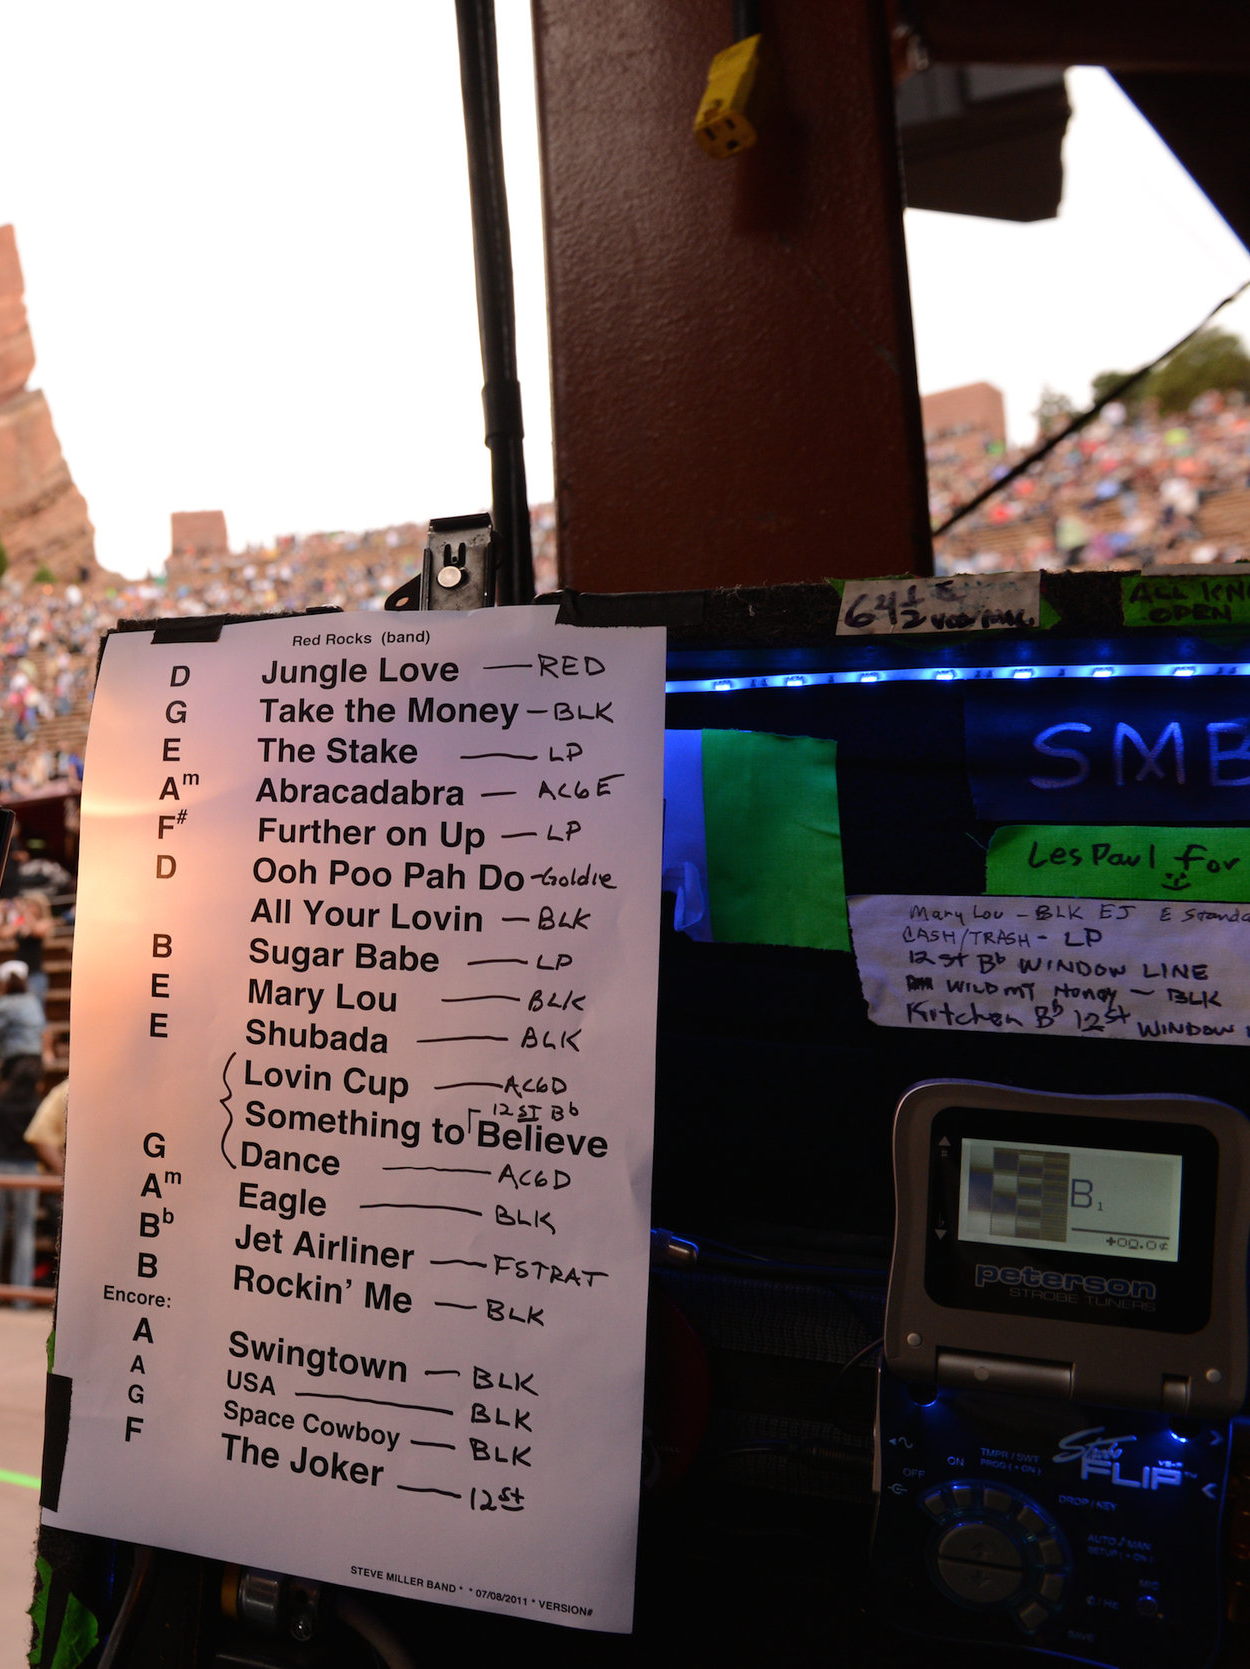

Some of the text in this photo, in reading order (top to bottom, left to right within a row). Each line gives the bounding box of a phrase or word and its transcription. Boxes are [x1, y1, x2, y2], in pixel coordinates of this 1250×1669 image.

[1202, 581, 1250, 602] KN
[1150, 604, 1231, 622] OPEN
[293, 631, 430, 646] Red Rocks (band)
[170, 666, 190, 687] D
[262, 658, 459, 689] Jungle Love
[538, 654, 605, 678] RED
[166, 700, 186, 723] G
[260, 697, 519, 730] Take the Money
[554, 702, 613, 723] BLK
[163, 738, 180, 761] E
[258, 738, 417, 764] The Stake
[550, 742, 583, 761] LP
[256, 778, 464, 806] Abracadabra
[259, 818, 485, 854] Further on Up
[547, 821, 581, 841] LP
[157, 855, 176, 878] D
[1028, 841, 1082, 868] Les
[1091, 844, 1156, 868] Paul
[253, 857, 524, 891] Ooh Poo Pah Do
[251, 898, 482, 932] All Your Lovin
[538, 906, 590, 930] BLK
[909, 905, 965, 925] Mary
[973, 905, 1004, 920] Lou
[1036, 904, 1084, 921] BLK
[153, 934, 172, 958] B
[1064, 928, 1102, 948] LP
[250, 938, 439, 972] Sugar Babe
[537, 954, 572, 970] LP
[1019, 957, 1126, 978] WINDOW
[1142, 963, 1208, 980] LINE
[152, 973, 169, 998] E
[249, 979, 396, 1014] Mary Lou
[1167, 987, 1222, 1008] BLK
[528, 990, 586, 1012] BLK
[150, 1013, 168, 1038] E
[246, 1019, 387, 1053] Shubada
[1137, 1021, 1235, 1038] WINDOW
[521, 1027, 581, 1052] BLK
[245, 1060, 408, 1103] Lovin Cup
[246, 1101, 607, 1158] Something to Believe
[144, 1133, 165, 1158] G
[242, 1141, 339, 1175] Dance
[239, 1182, 326, 1220] Eagle
[496, 1205, 555, 1235] BLK
[235, 1224, 414, 1269] Jet Airliner
[138, 1252, 157, 1278] B
[494, 1254, 609, 1287] FSTRAT
[234, 1265, 412, 1313] Rockin' Me
[974, 1263, 1158, 1301] peterson
[104, 1285, 170, 1308] Encore:
[1009, 1288, 1157, 1312] STROBE TUNERS
[487, 1299, 544, 1326] BLK
[133, 1318, 153, 1343] A
[130, 1355, 145, 1374] A
[229, 1331, 406, 1382] Swingtown
[227, 1370, 275, 1395] USA
[474, 1366, 538, 1396] BLK
[128, 1384, 143, 1404] G
[125, 1416, 143, 1442] F
[224, 1400, 400, 1452] Space Cowboy
[471, 1403, 532, 1432] BLK
[222, 1433, 384, 1486] The Joker
[469, 1438, 531, 1467] BLK
[946, 1456, 965, 1466] ON
[902, 1467, 926, 1478] OFF
[1080, 1455, 1183, 1491] FLIP
[351, 1566, 593, 1616] STEVE MILLER BAND 07/08/2011 VERSION#
